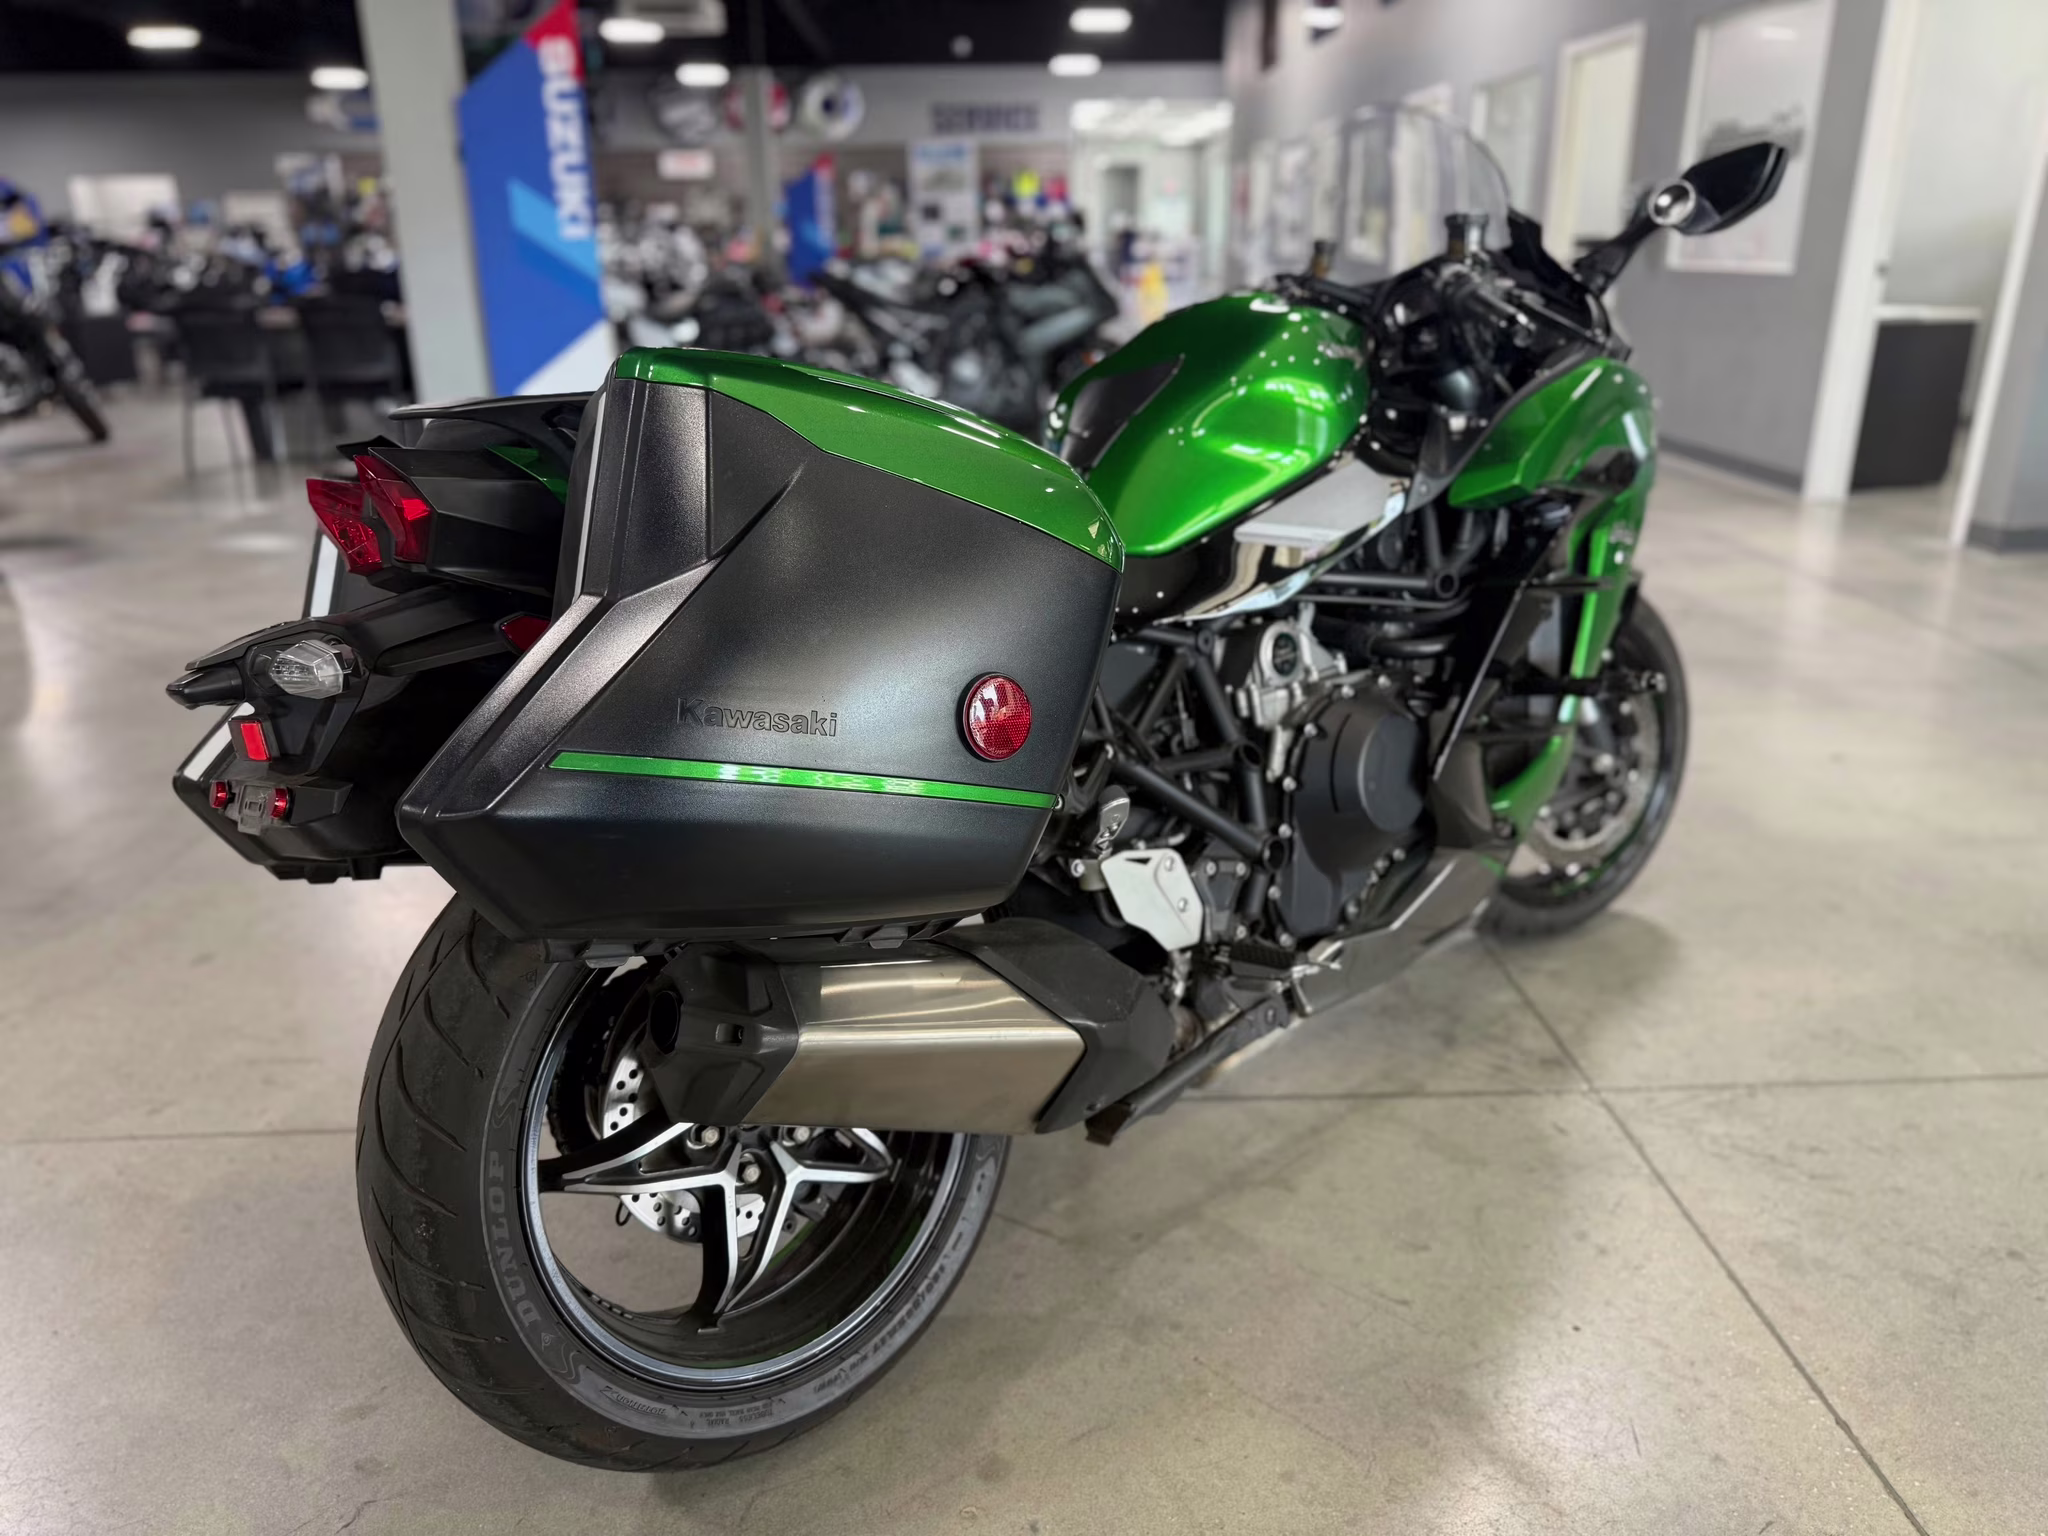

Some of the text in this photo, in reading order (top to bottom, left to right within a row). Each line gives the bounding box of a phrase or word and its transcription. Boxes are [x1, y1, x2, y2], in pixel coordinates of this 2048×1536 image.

[537, 35, 593, 240] SUZUKI
[676, 698, 838, 737] Kawasaki
[488, 1150, 542, 1328] DUNLOP
